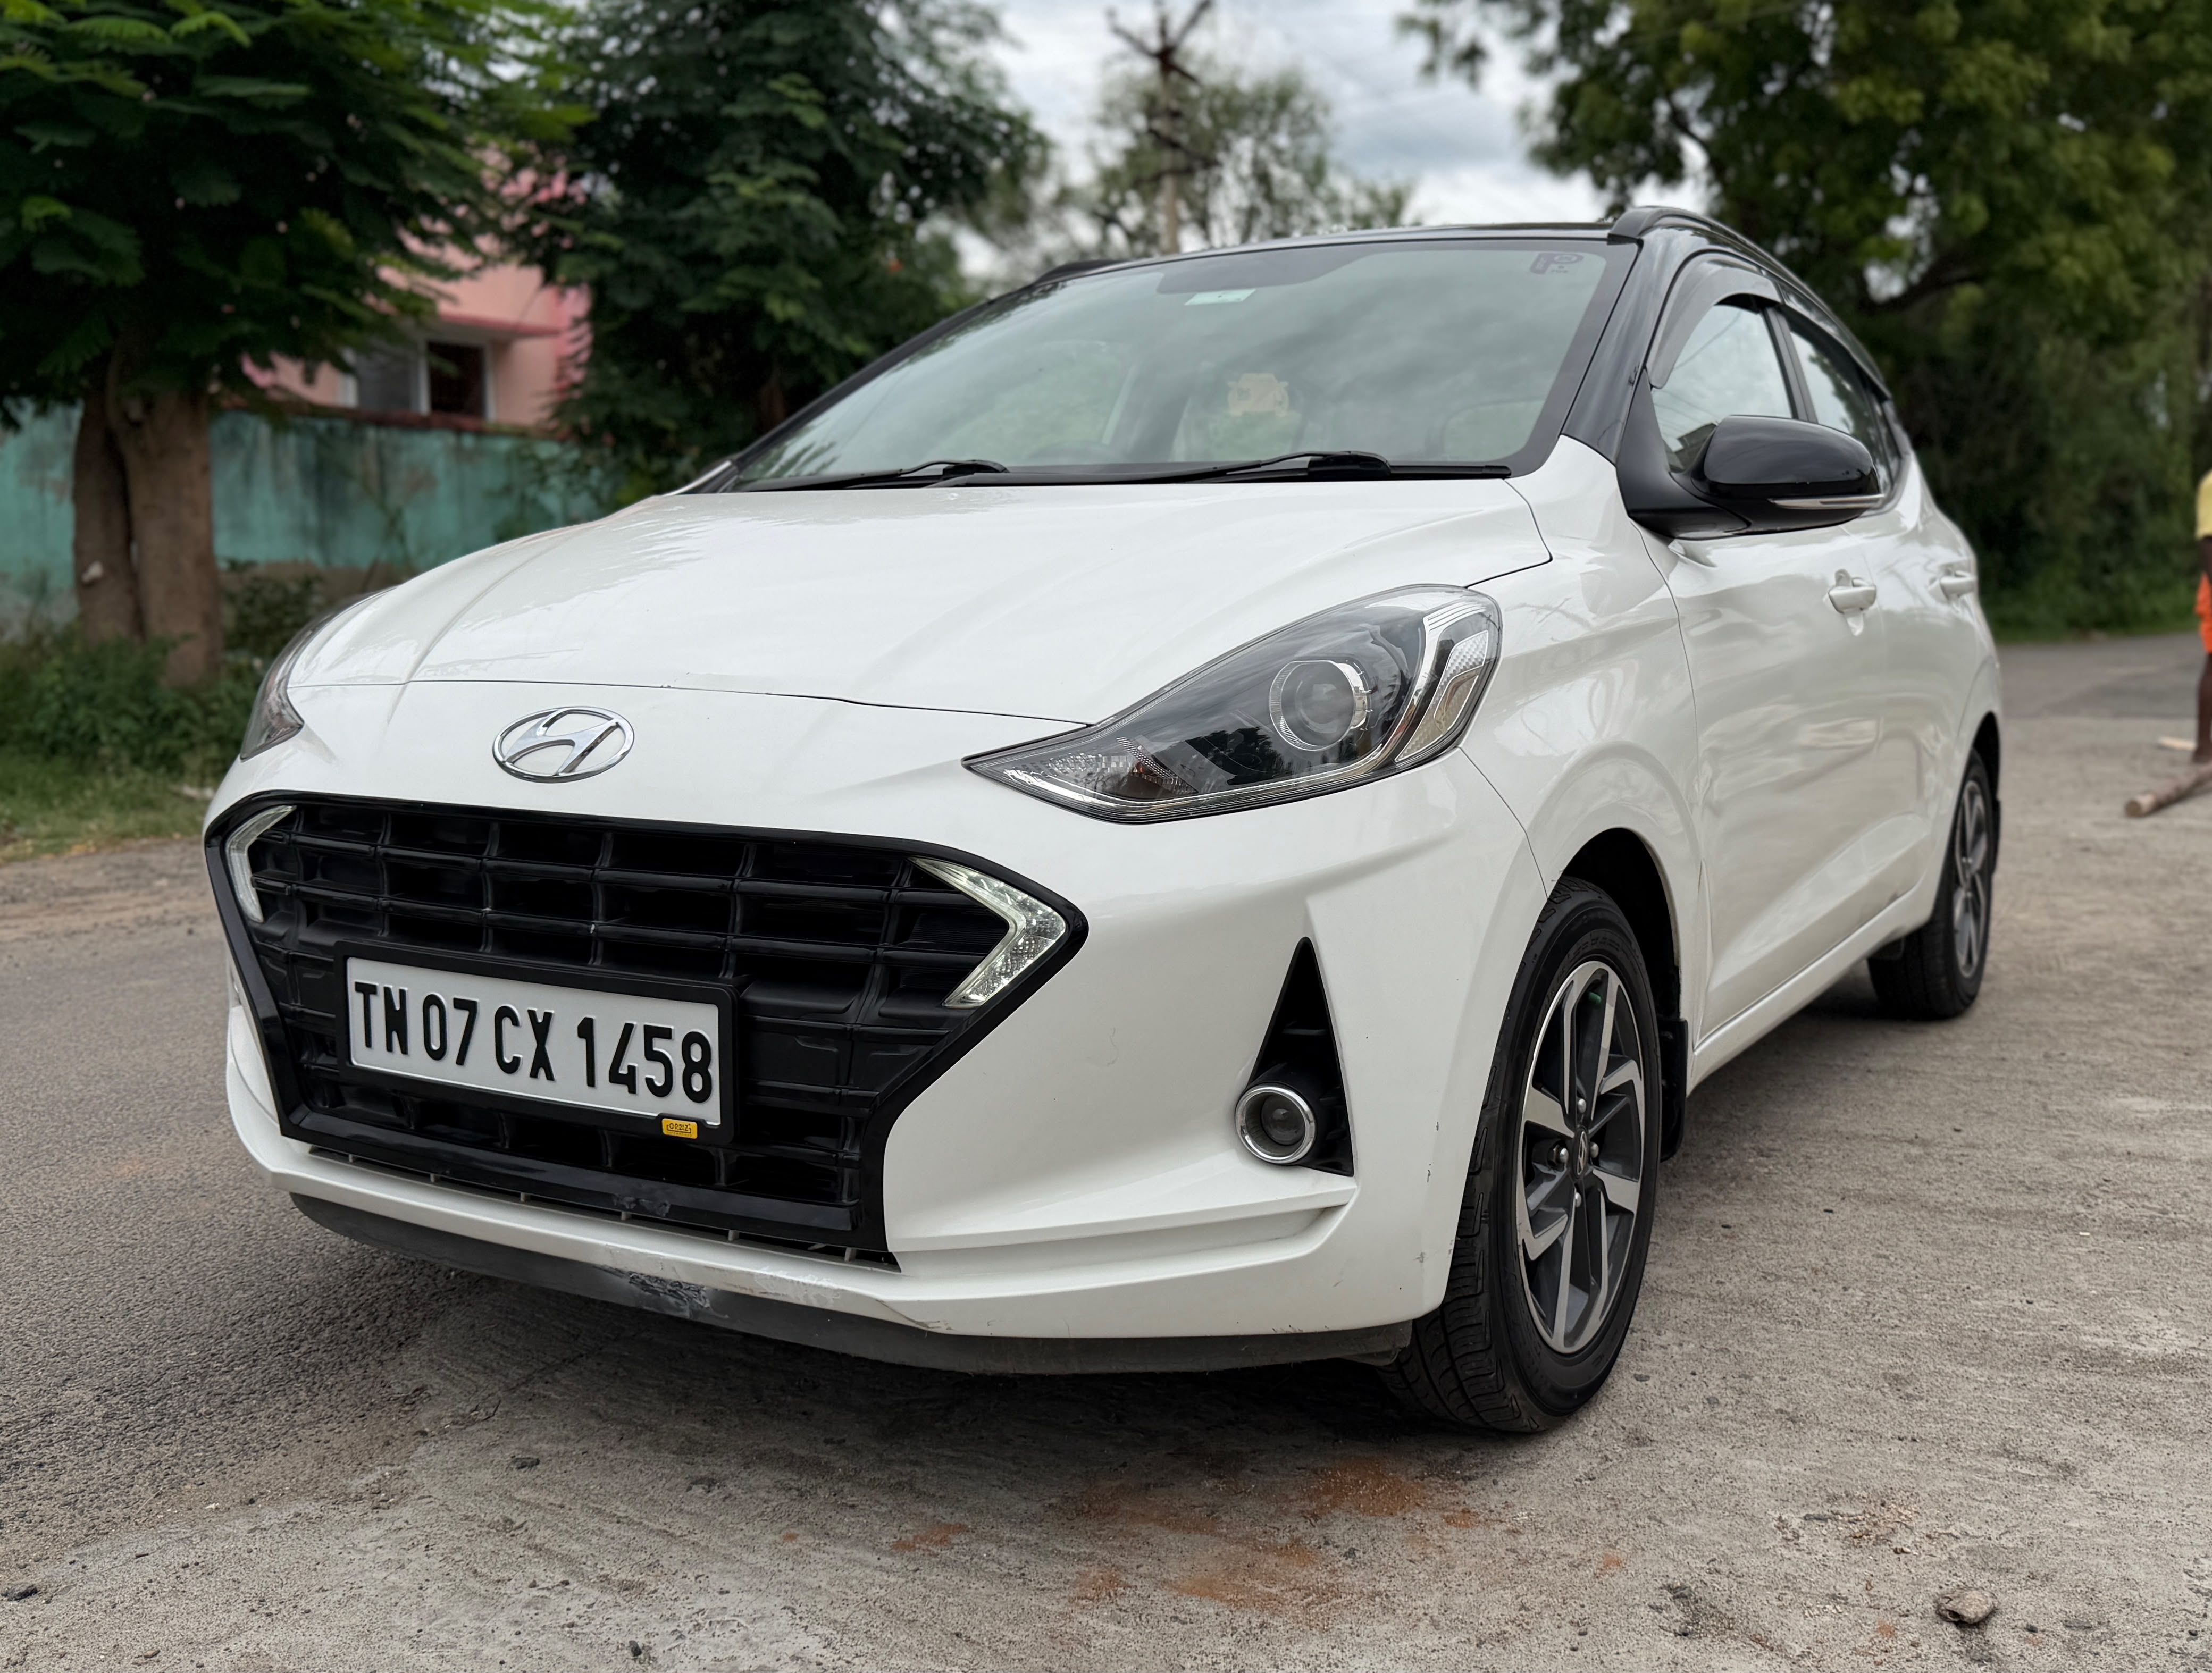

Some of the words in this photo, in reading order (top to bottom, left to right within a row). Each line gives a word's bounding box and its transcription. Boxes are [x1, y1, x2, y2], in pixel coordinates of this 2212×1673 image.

[355, 982, 408, 1055] TN
[422, 994, 478, 1066] 07
[494, 1005, 555, 1081] CX
[577, 1016, 713, 1103] 1458
